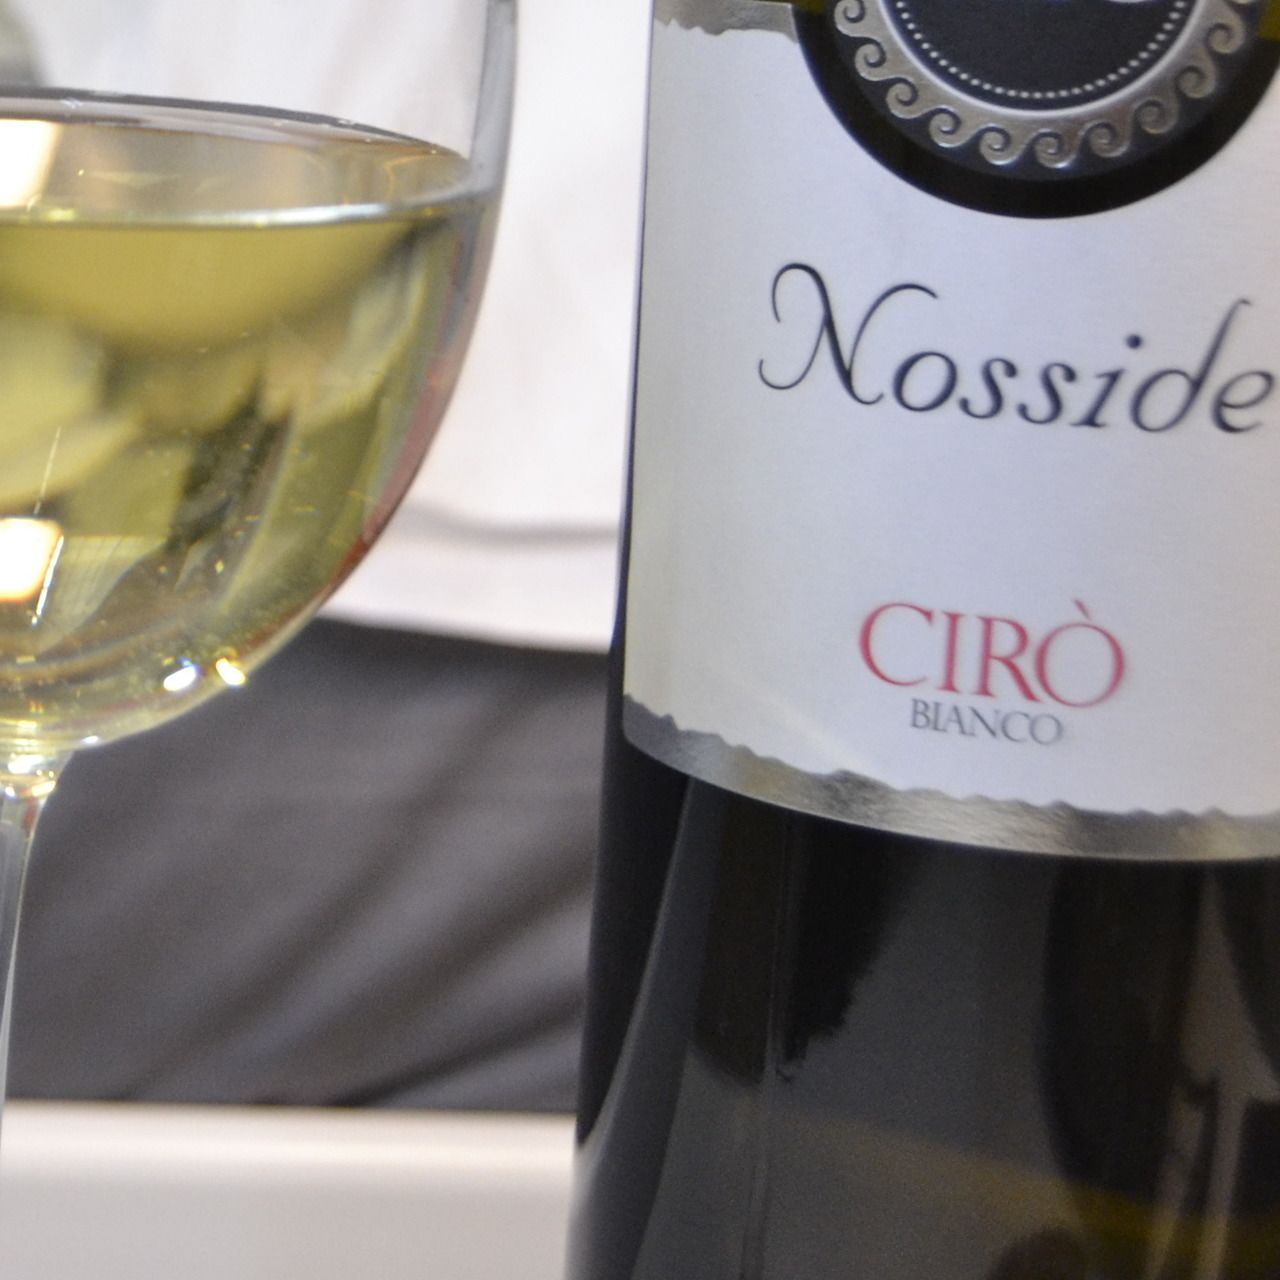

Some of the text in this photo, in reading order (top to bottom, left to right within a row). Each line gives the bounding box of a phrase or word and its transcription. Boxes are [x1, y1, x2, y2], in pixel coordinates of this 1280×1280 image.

[759, 262, 1276, 434] Nosside
[858, 599, 1127, 709] CIRÒ
[910, 698, 1064, 746] BIANCO
